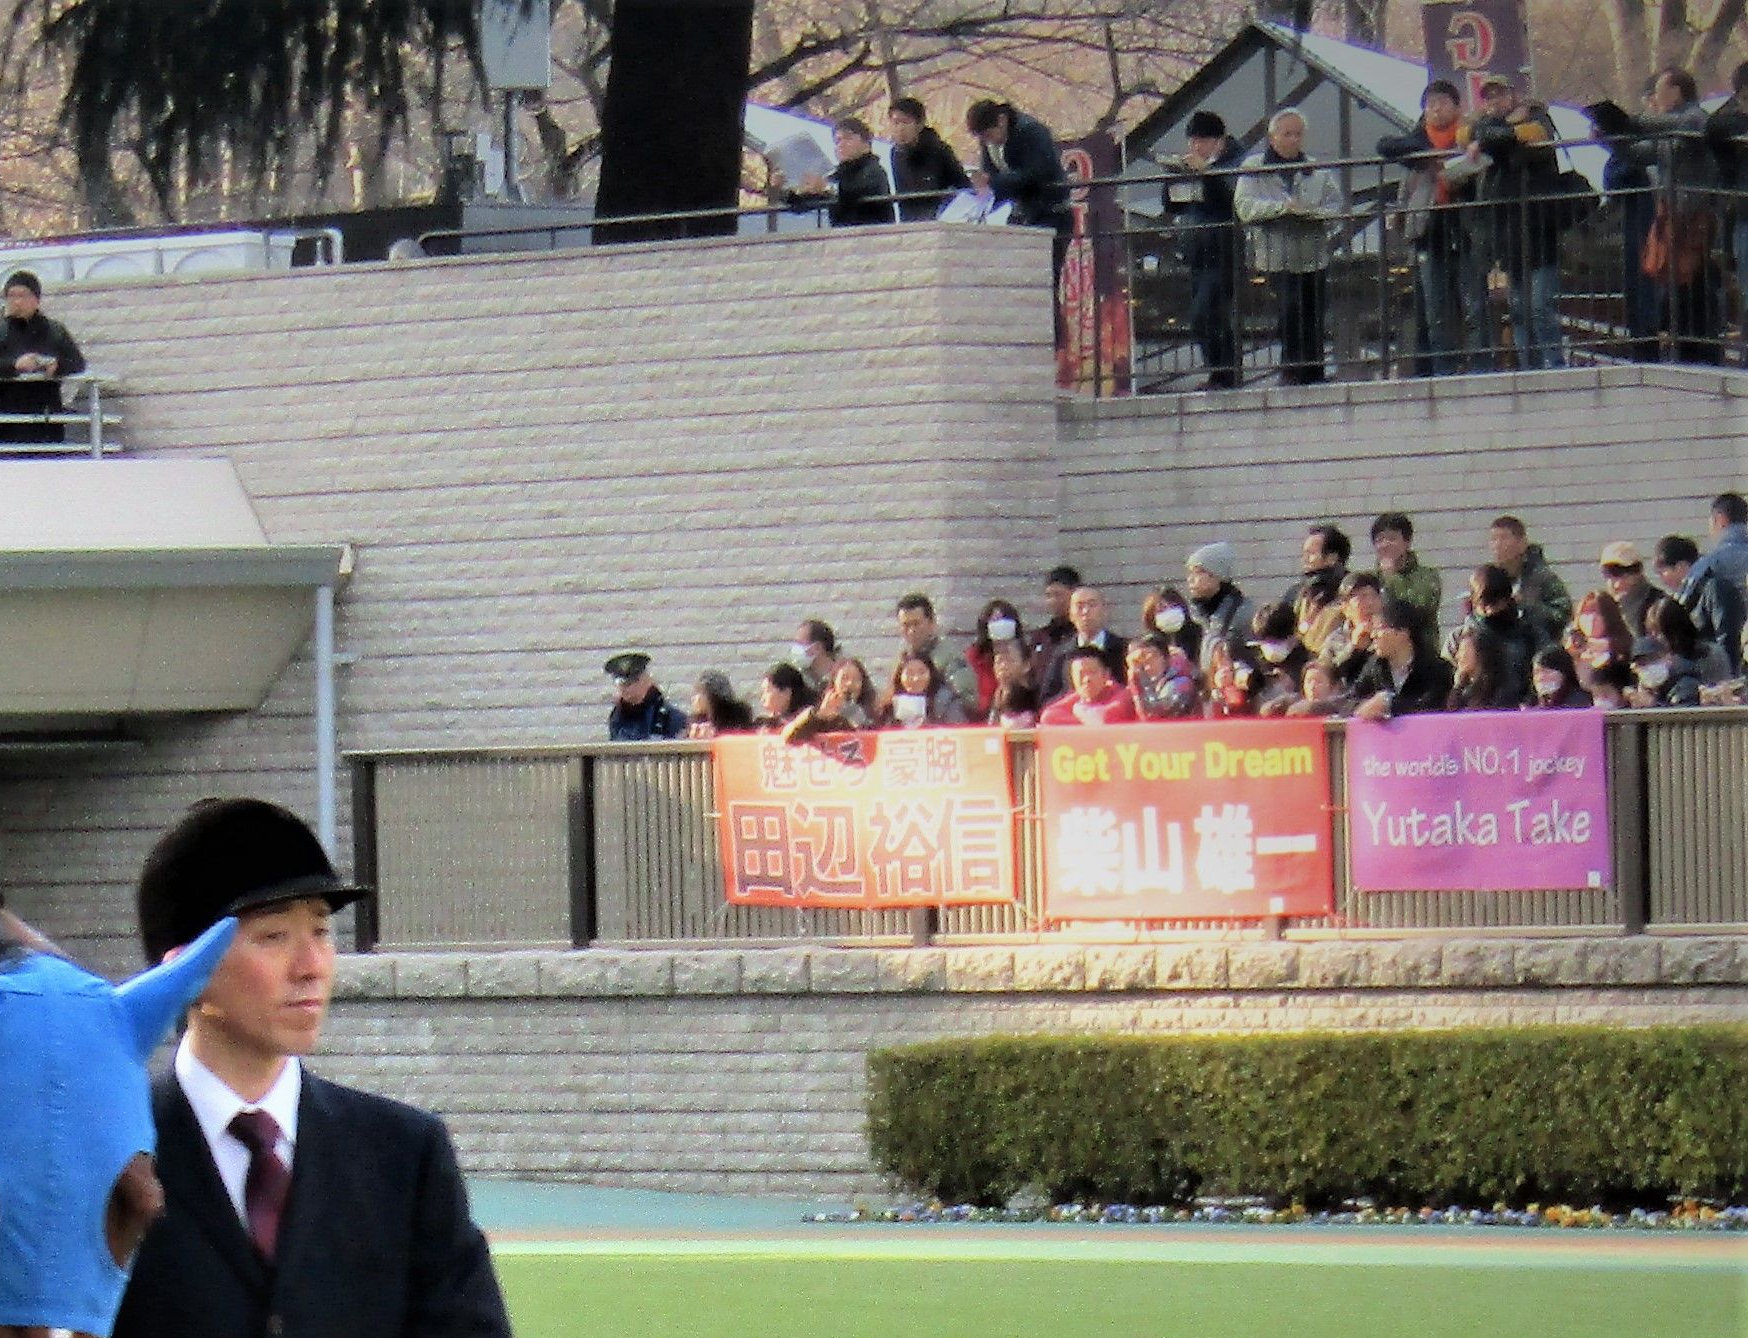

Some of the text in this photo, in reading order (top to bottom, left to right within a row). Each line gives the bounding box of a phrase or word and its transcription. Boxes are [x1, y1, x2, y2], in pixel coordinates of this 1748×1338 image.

[1052, 741, 1314, 783] Get Your Dream
[1362, 756, 1390, 777] the
[1525, 755, 1585, 782] jockey
[1361, 799, 1592, 847] Yutaka Take
